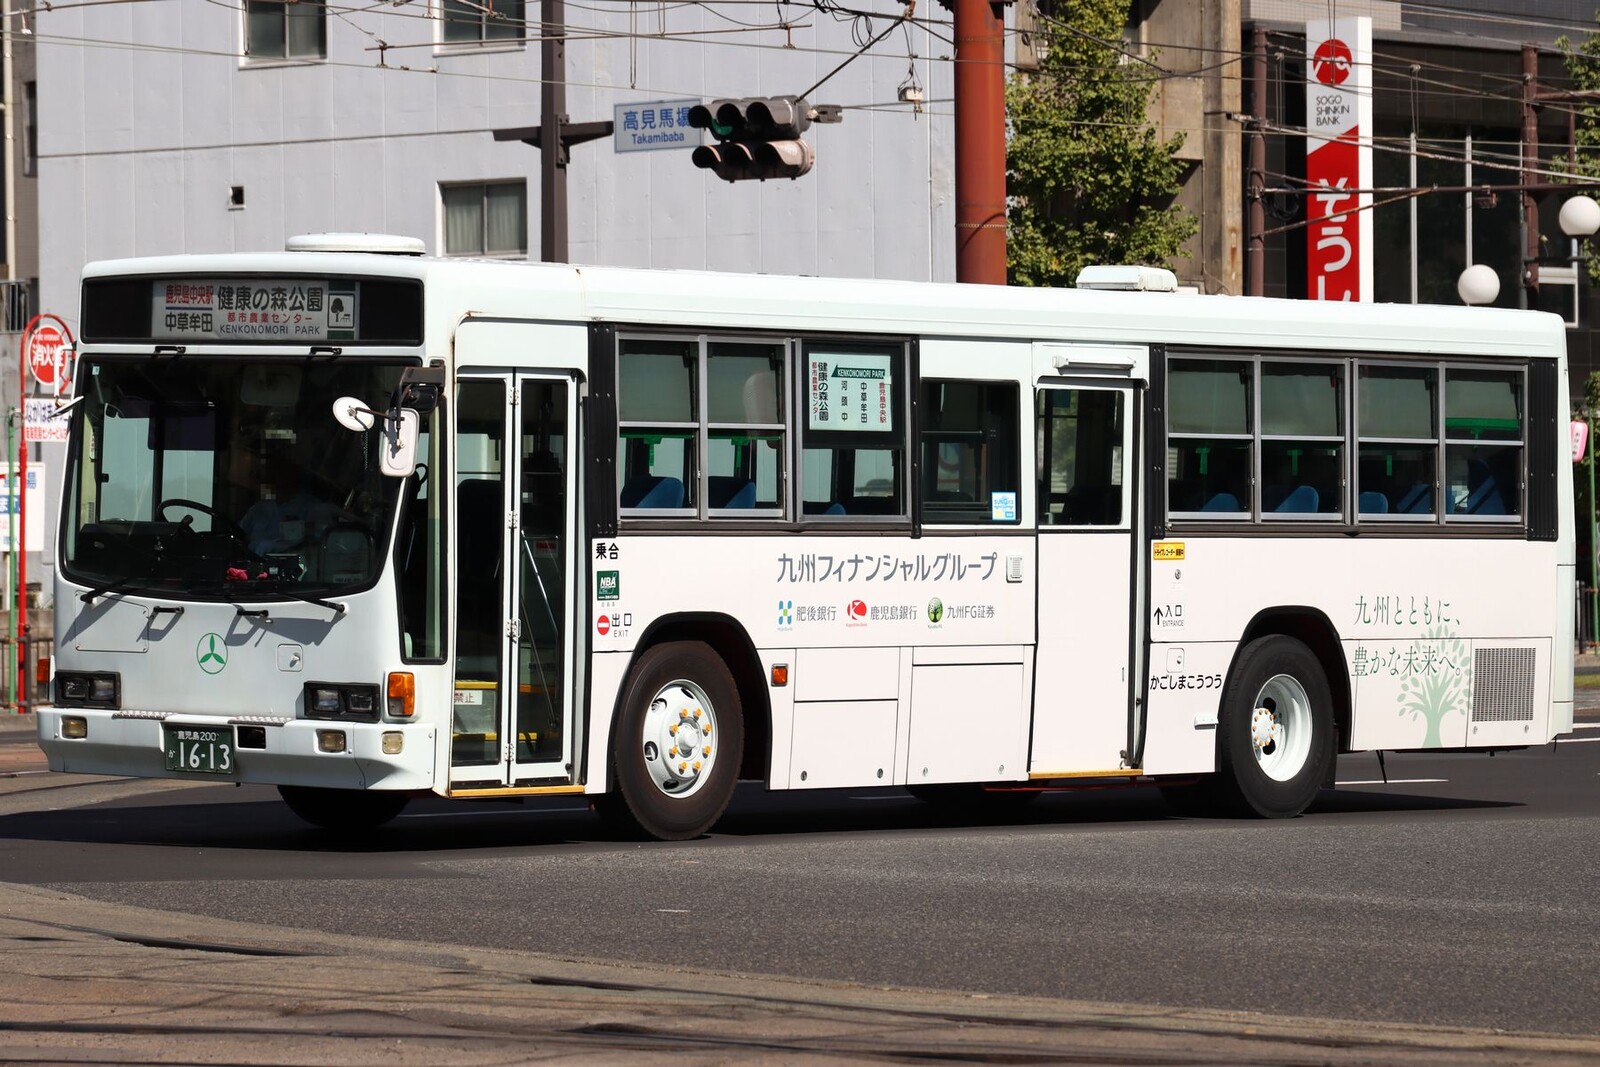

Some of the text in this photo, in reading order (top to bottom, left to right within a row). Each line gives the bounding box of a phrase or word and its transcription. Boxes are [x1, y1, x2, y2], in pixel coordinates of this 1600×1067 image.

[1316, 95, 1342, 105] SOGO
[1316, 105, 1350, 116] SHINKIN
[623, 107, 692, 131] 高見馬場
[1316, 115, 1341, 126] BANK
[631, 132, 685, 145] Takamibaba
[165, 284, 214, 305] 鹿児島中央駅
[217, 285, 323, 312] 健康の森公園
[165, 312, 213, 333] 中草牟田
[227, 312, 313, 324] 都市農業センター
[219, 325, 321, 336] KENKONOMORI PARK
[837, 368, 886, 378] KENKONOMORI PARK
[818, 362, 829, 421] 健康の森公園
[860, 382, 868, 423] 中草牟田
[595, 542, 619, 560] 乗合
[777, 551, 998, 583] 九州フィナンシャルグループ
[600, 577, 616, 587] NBA
[796, 605, 837, 622] 肥後銀行
[870, 604, 918, 621] 鹿児島銀行
[947, 604, 996, 619] 九州FG証券
[1165, 605, 1182, 618] 入口
[1354, 596, 1460, 625] 九州とともに、
[611, 613, 632, 627] 出口
[613, 629, 629, 638] EXIT
[1351, 645, 1461, 677] 豊かな未来へ。
[1150, 674, 1222, 690] かごしまこうつう
[180, 741, 230, 770] 16-13
